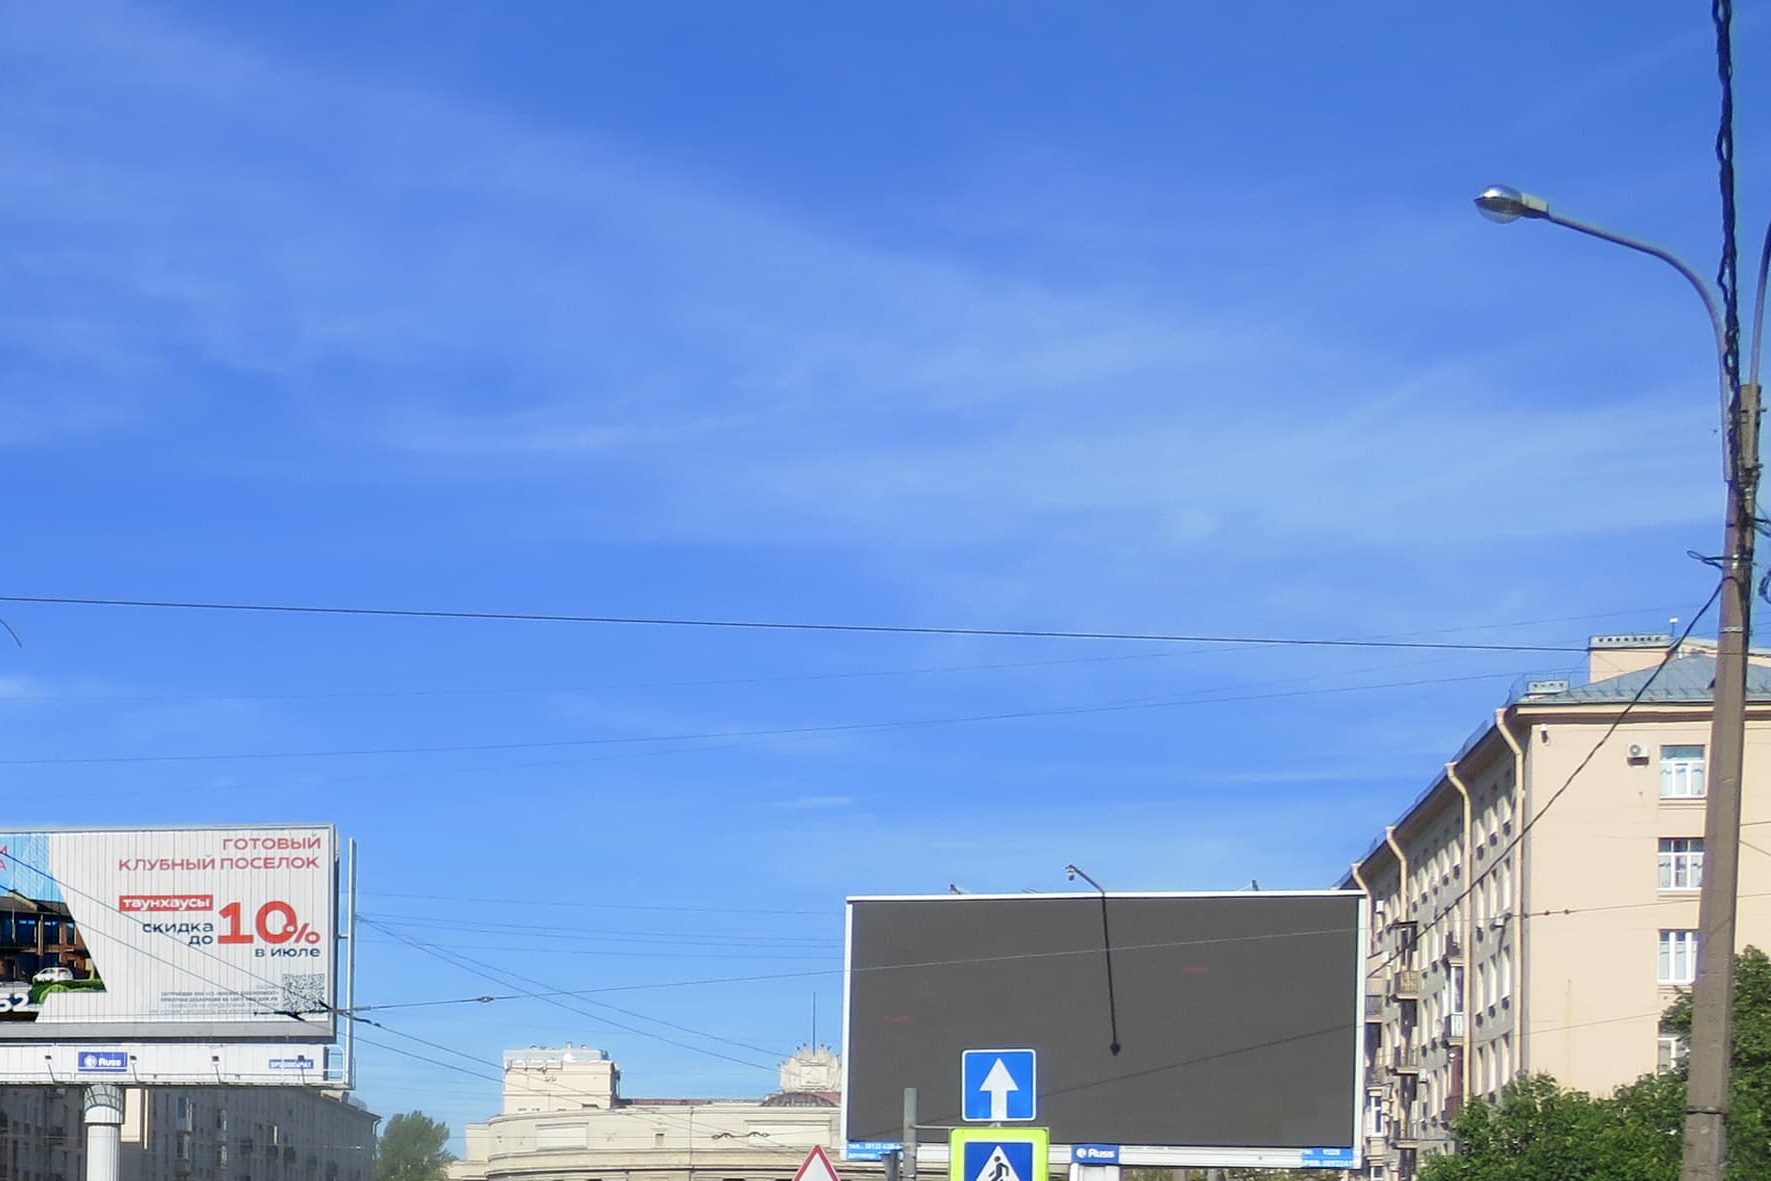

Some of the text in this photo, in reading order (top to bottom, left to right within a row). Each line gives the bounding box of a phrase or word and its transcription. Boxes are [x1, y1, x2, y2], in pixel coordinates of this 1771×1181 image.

[222, 834, 321, 850] ГОТОВЫЙ
[118, 855, 320, 871] КЛУБНЫЙ ПОСЕЛОК
[122, 897, 211, 911] таунхаусы
[142, 922, 214, 934] скидка
[218, 900, 321, 945] 10%
[188, 935, 213, 946] до
[255, 947, 321, 958] в июле
[98, 1058, 122, 1067] Russ
[1088, 1148, 1115, 1158] Russ
